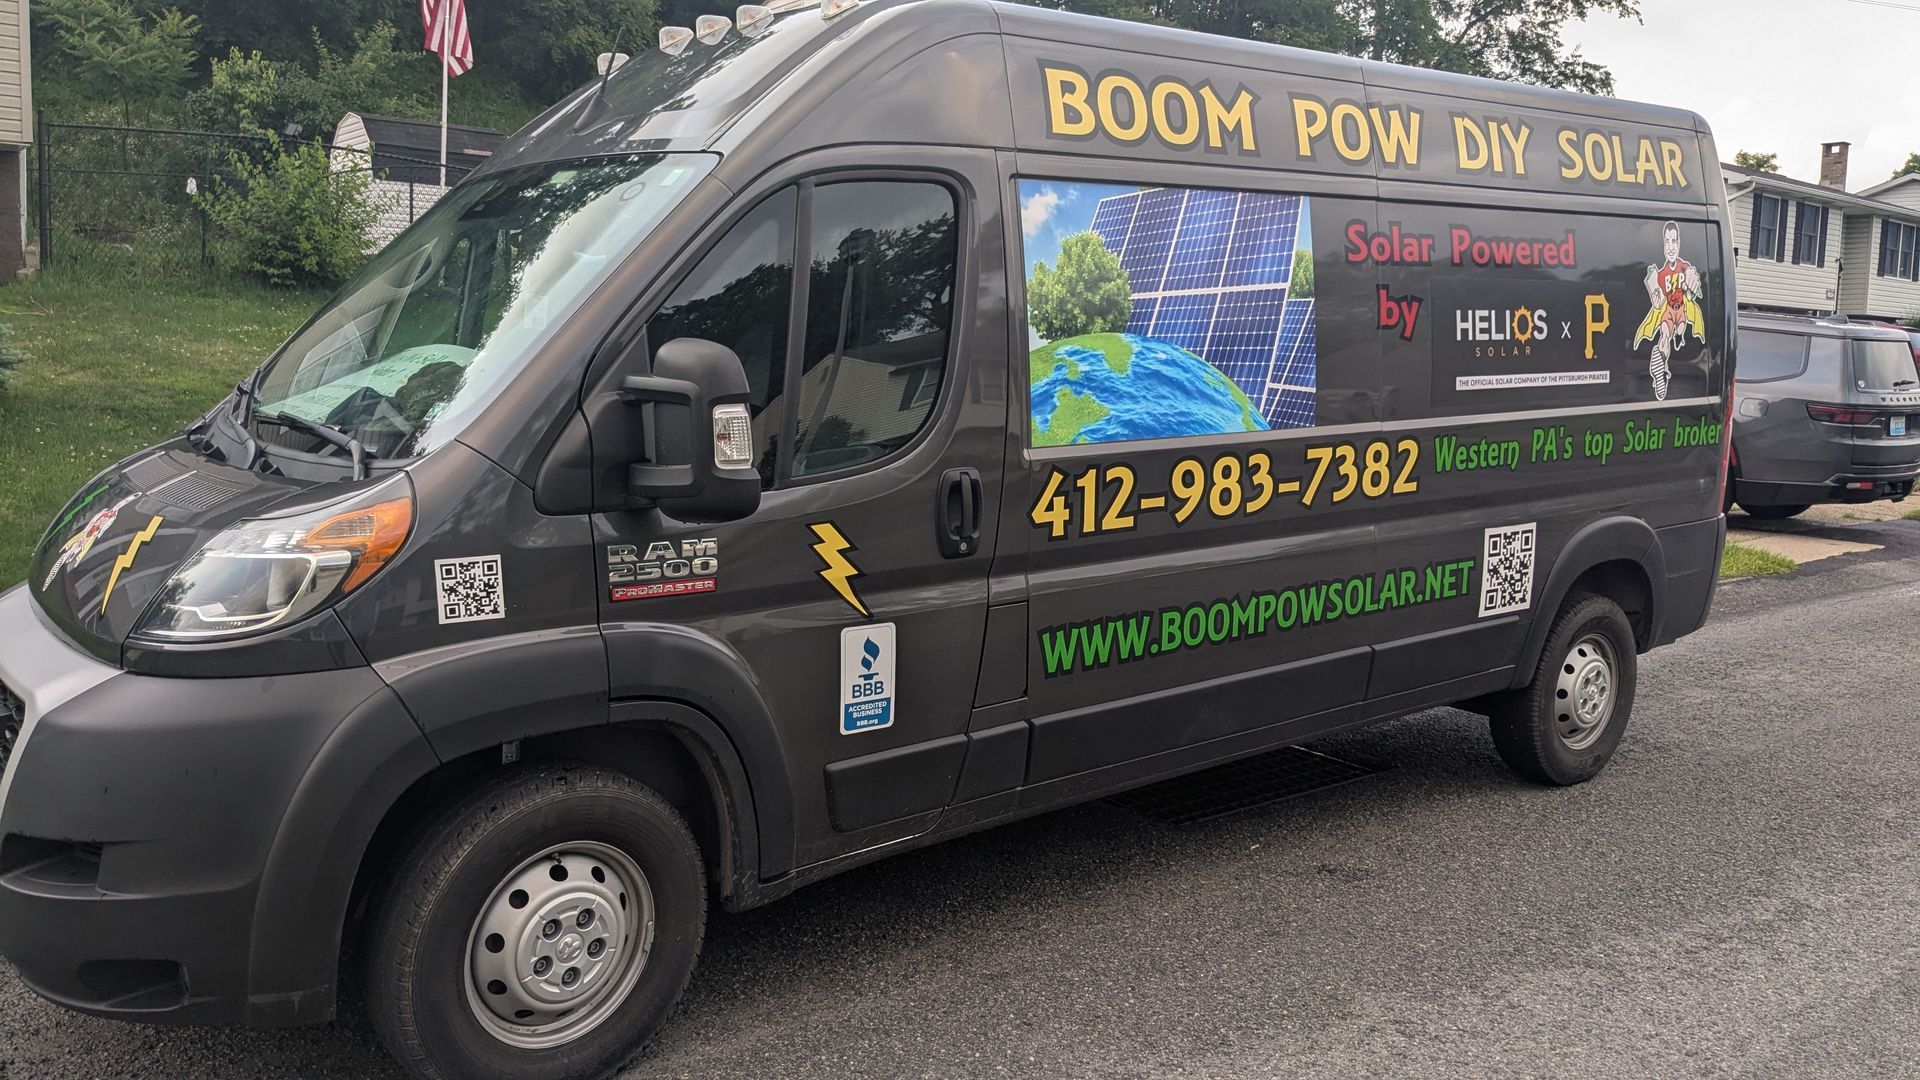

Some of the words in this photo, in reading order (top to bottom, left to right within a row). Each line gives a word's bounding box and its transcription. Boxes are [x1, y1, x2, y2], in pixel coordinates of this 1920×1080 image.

[1043, 67, 1257, 152] BOOM
[1292, 98, 1420, 166] POW
[1455, 117, 1530, 175] DIY
[1558, 130, 1688, 188] SOLAR
[1346, 223, 1433, 262] Solar
[1451, 228, 1575, 266] Powered
[1378, 288, 1420, 338] by
[1456, 305, 1548, 345] HELIOS
[1475, 346, 1531, 357] SOLAR
[1470, 379, 1494, 387] OFFICIAL
[1514, 376, 1540, 384] COMPANY
[1559, 374, 1588, 382] PITTSBURGH
[1589, 373, 1608, 381] PIRATES
[1434, 435, 1520, 471] Western
[1531, 426, 1573, 463] PA's
[1584, 430, 1614, 465] top
[1622, 419, 1667, 454] Solar
[1673, 415, 1722, 448] broker
[1030, 439, 1420, 538] 412-983-7382
[607, 538, 718, 563] RAM
[608, 557, 718, 583] 2500
[1042, 560, 1475, 674] WWW.BOOMPOWSOLAR.NET
[848, 701, 887, 712] ACCREDITED
[852, 681, 885, 699] BBB
[852, 708, 882, 718] BUSINESS
